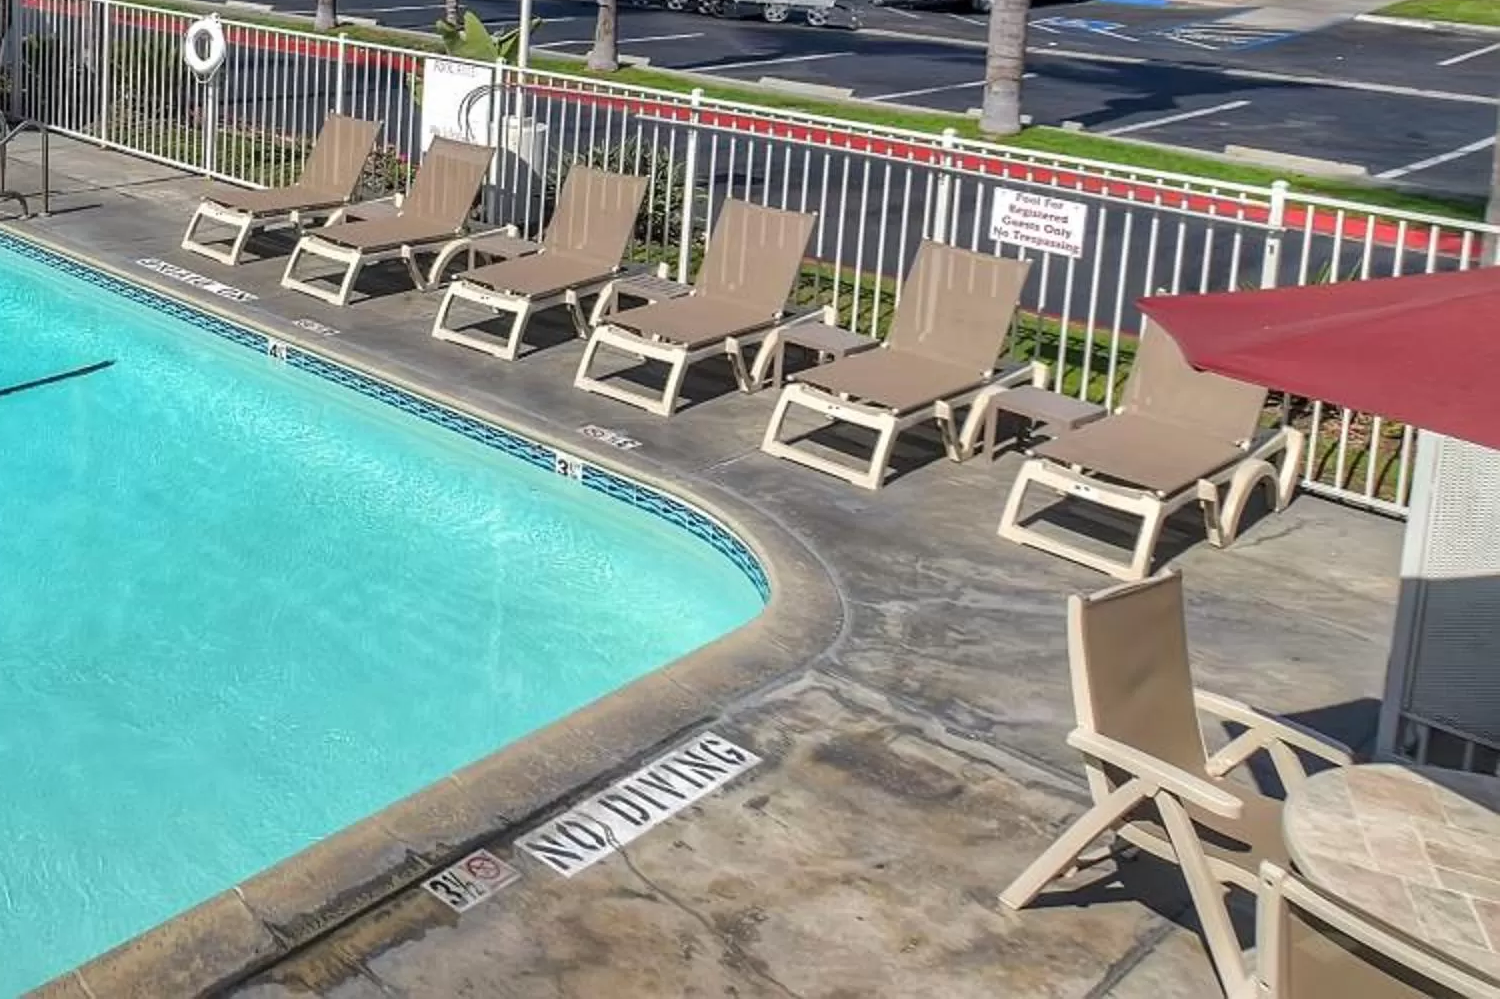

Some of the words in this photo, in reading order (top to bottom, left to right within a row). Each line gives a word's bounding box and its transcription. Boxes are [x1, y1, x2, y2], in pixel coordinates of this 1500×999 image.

[1008, 203, 1069, 224] Registered
[1015, 192, 1040, 205] Pool
[1044, 198, 1064, 210] For
[1001, 214, 1040, 232] Guests
[1043, 223, 1072, 239] Only
[993, 225, 1009, 238] No
[1013, 230, 1080, 254] Trespassing
[525, 819, 606, 871] NO
[597, 738, 747, 826] DIVING
